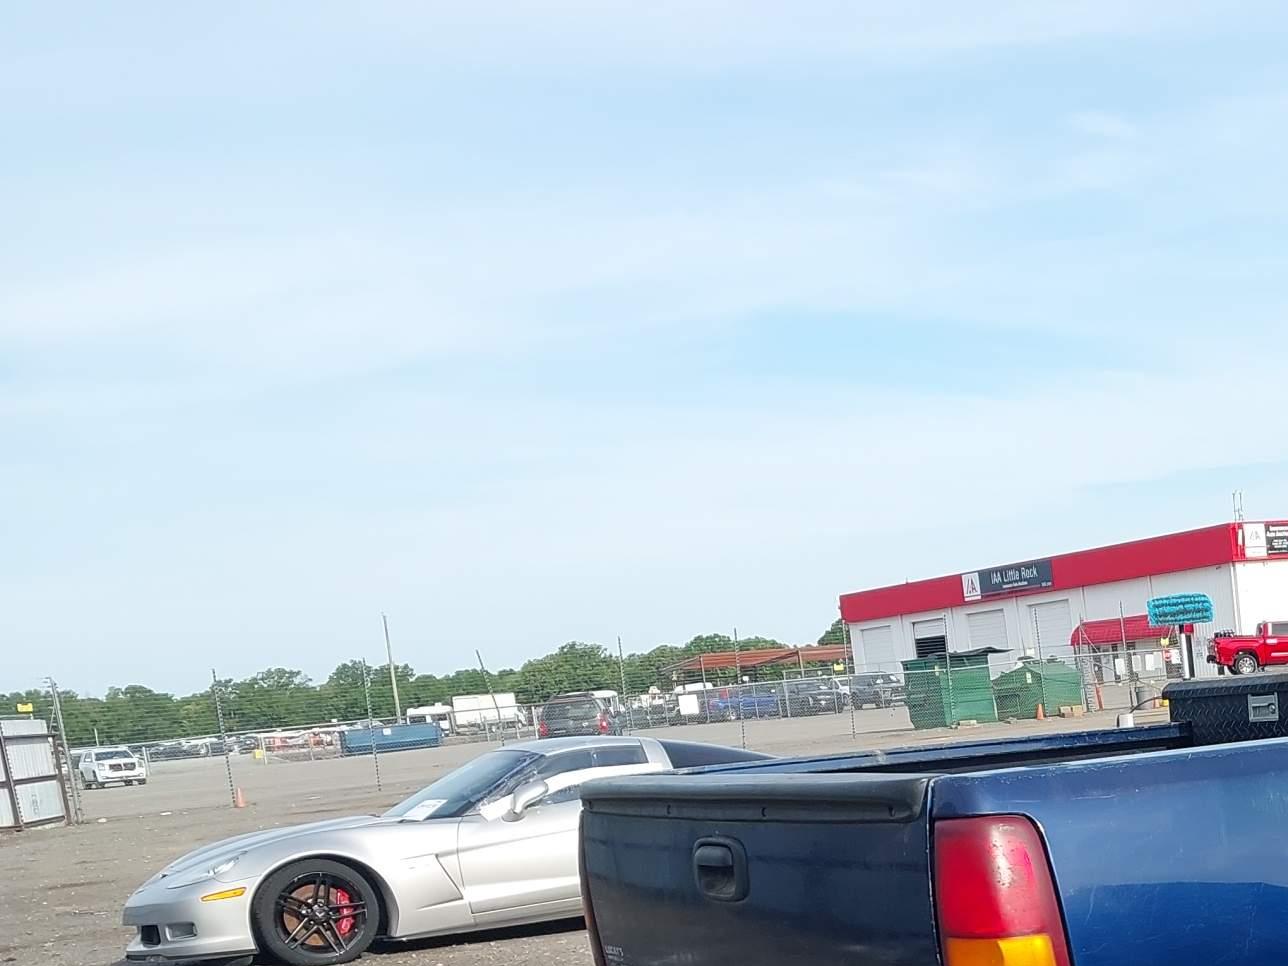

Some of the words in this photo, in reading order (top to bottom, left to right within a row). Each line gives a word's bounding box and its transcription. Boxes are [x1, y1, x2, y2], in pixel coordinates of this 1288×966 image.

[990, 571, 1002, 585] IAA
[1002, 569, 1020, 583] Little
[1021, 564, 1038, 579] Rock
